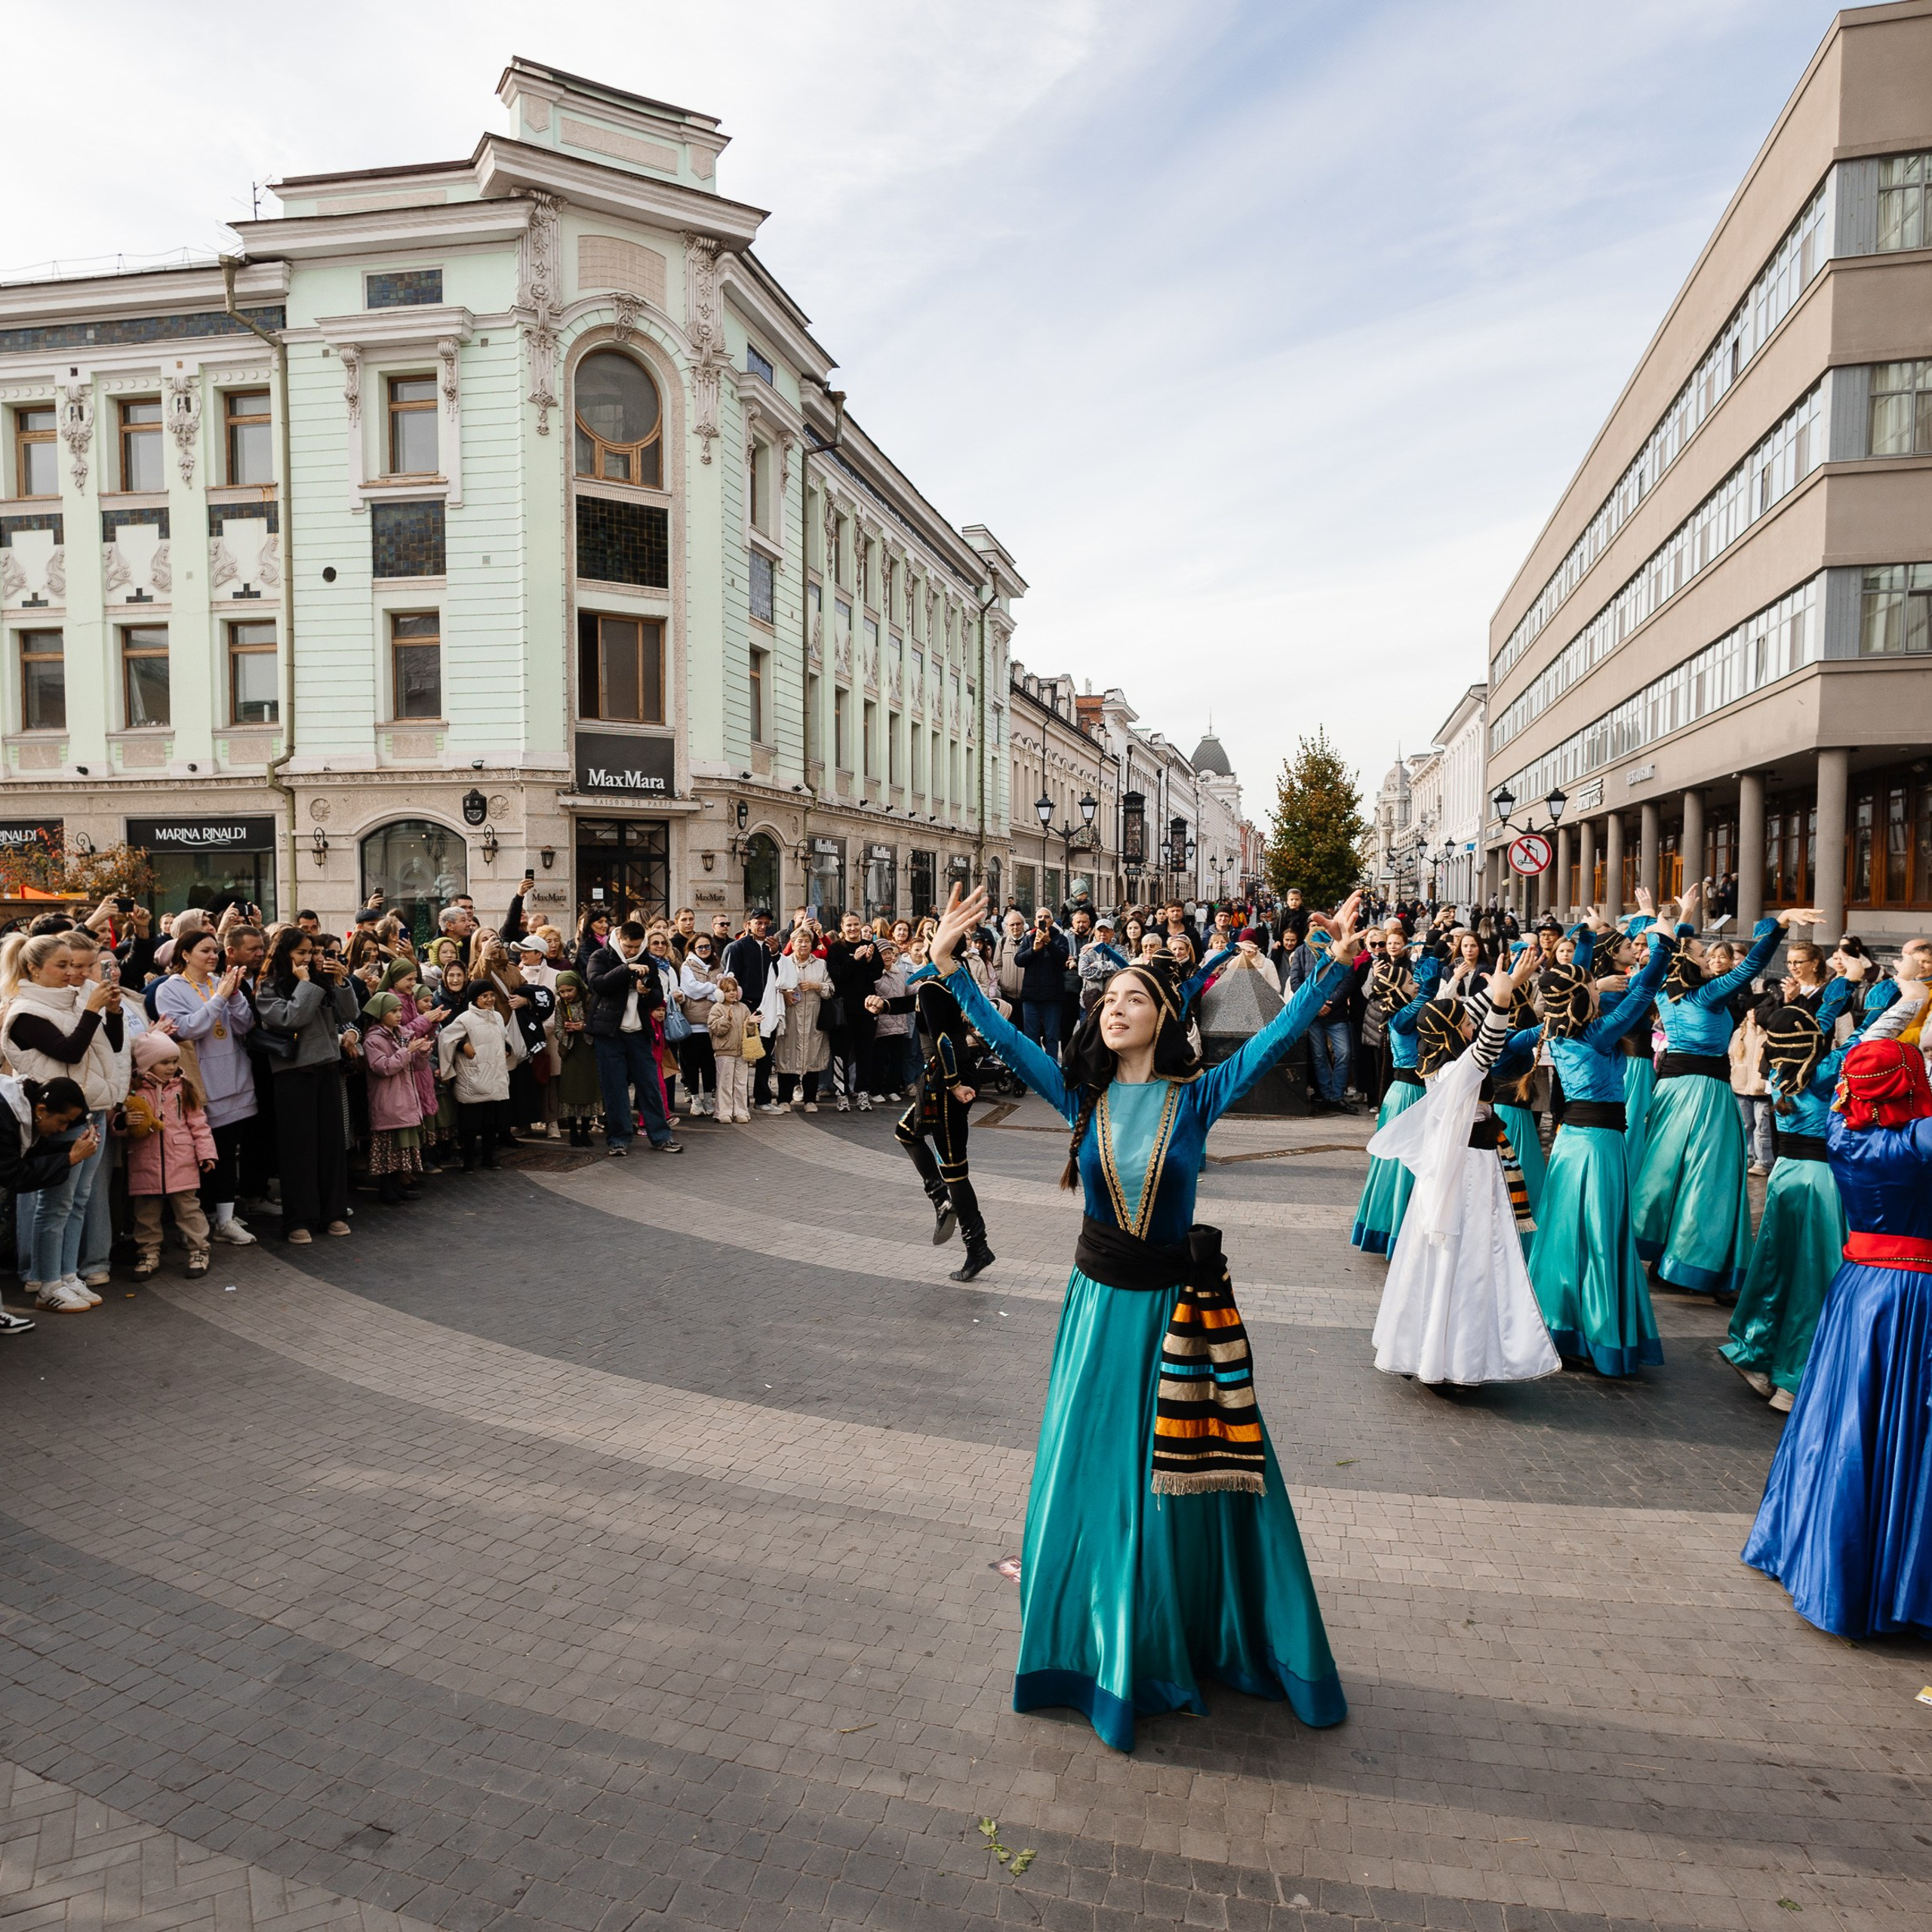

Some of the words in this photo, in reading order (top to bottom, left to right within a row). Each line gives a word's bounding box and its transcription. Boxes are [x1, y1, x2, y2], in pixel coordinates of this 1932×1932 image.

[587, 768, 666, 790] MaxMara
[592, 798, 626, 806] MAISON
[155, 828, 200, 843] MARINA
[202, 827, 246, 843] RINALDI
[532, 893, 567, 901] MaxMara
[695, 893, 725, 901] MaxMara
